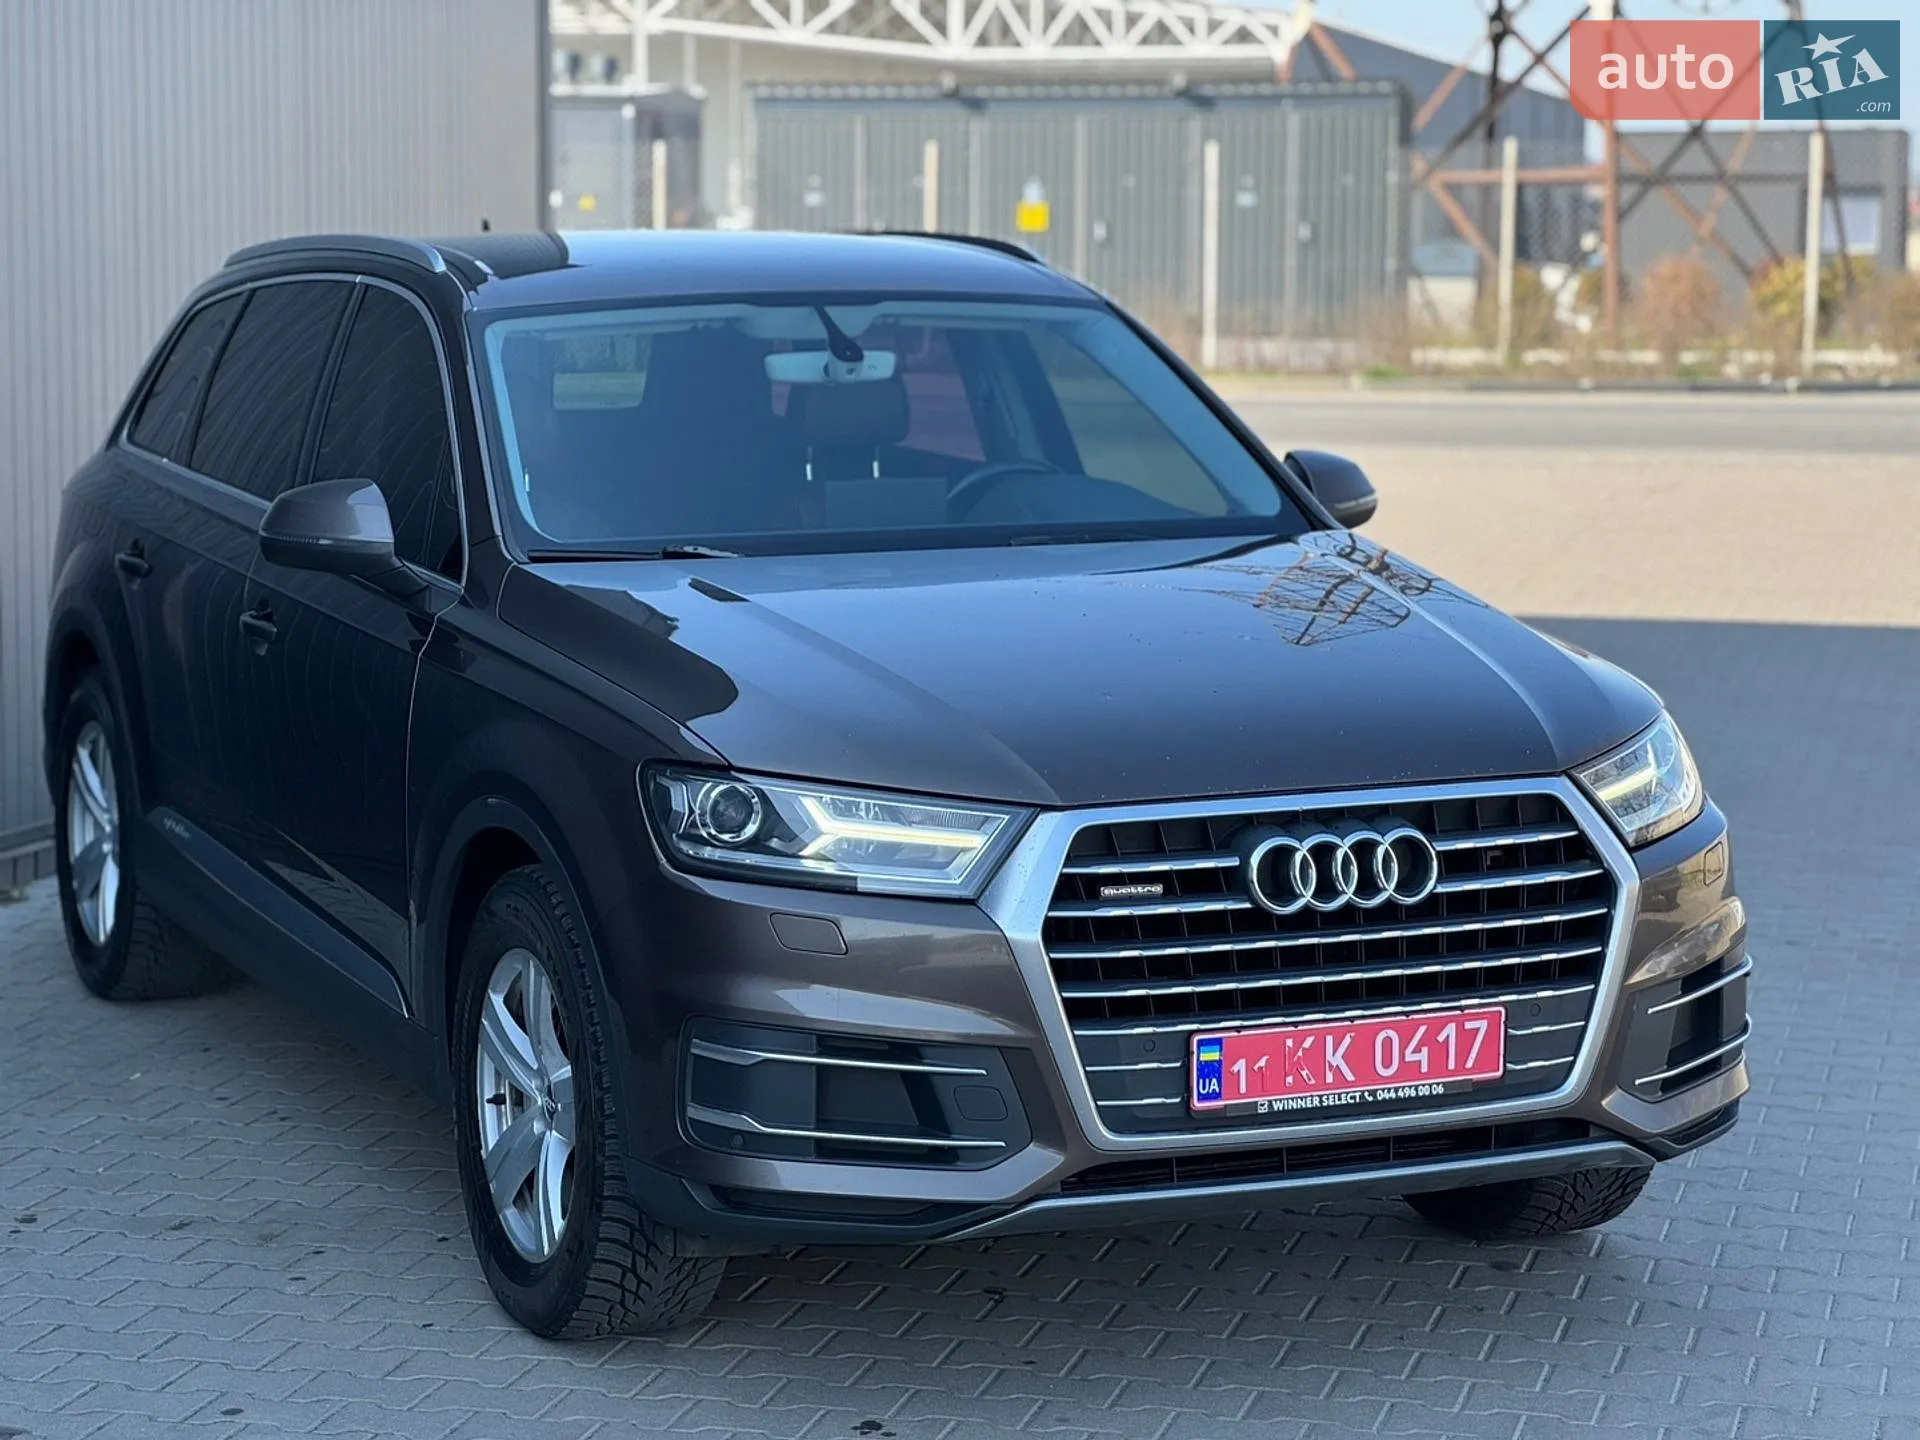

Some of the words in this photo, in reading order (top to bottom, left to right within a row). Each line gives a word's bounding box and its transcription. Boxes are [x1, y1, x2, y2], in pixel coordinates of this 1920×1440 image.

[1103, 886, 1161, 895] quattro
[1374, 1019, 1488, 1077] 0417
[1199, 1078, 1219, 1094] UA
[1272, 1096, 1320, 1111] WINNER
[1322, 1092, 1361, 1106] SELECT
[1376, 1088, 1396, 1100] 044
[1397, 1086, 1416, 1098] 496
[1418, 1084, 1430, 1096] 00
[1431, 1083, 1444, 1095] 06
